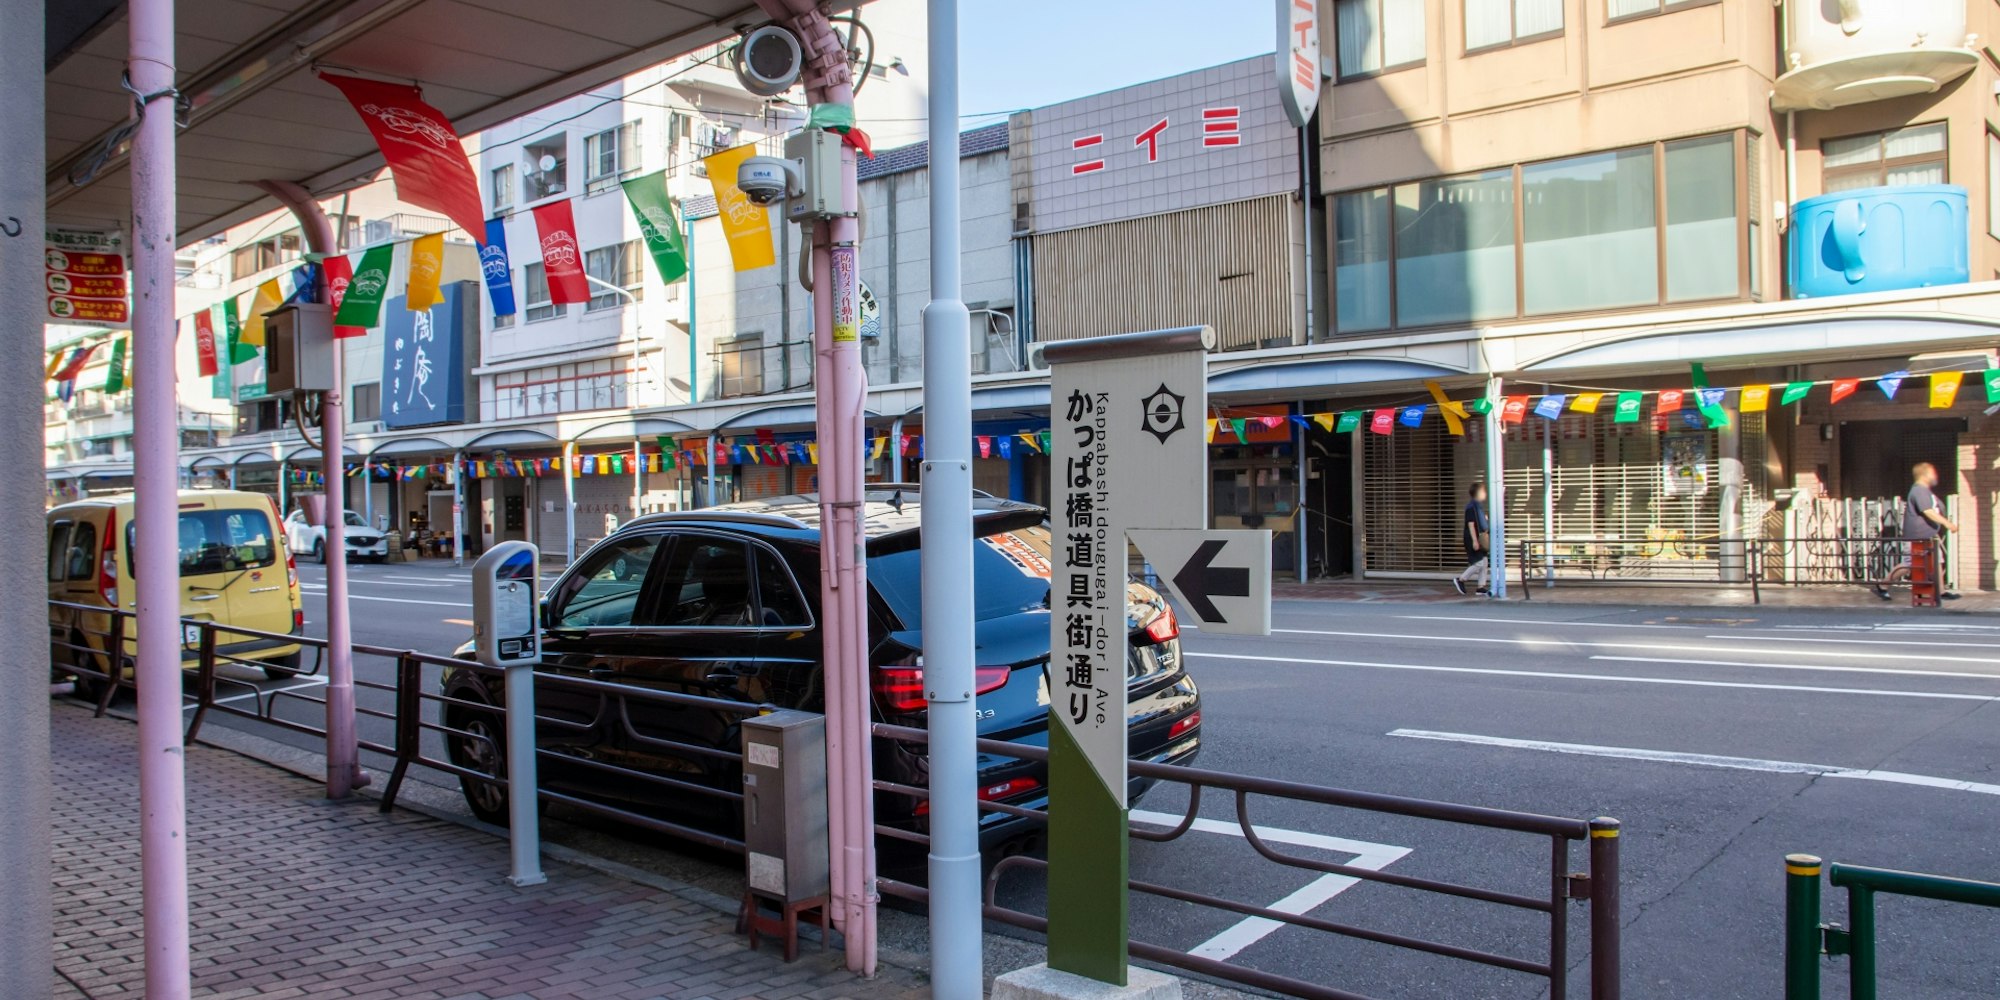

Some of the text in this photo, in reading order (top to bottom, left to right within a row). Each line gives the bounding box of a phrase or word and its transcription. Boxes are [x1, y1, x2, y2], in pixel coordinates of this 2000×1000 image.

[1072, 106, 1241, 176] ニイミ
[840, 254, 853, 325] 防犯カメラ作動中
[860, 283, 877, 311] 具街
[1066, 389, 1094, 725] かっぱ橋道具街通り
[1096, 688, 1109, 728] Ave.
